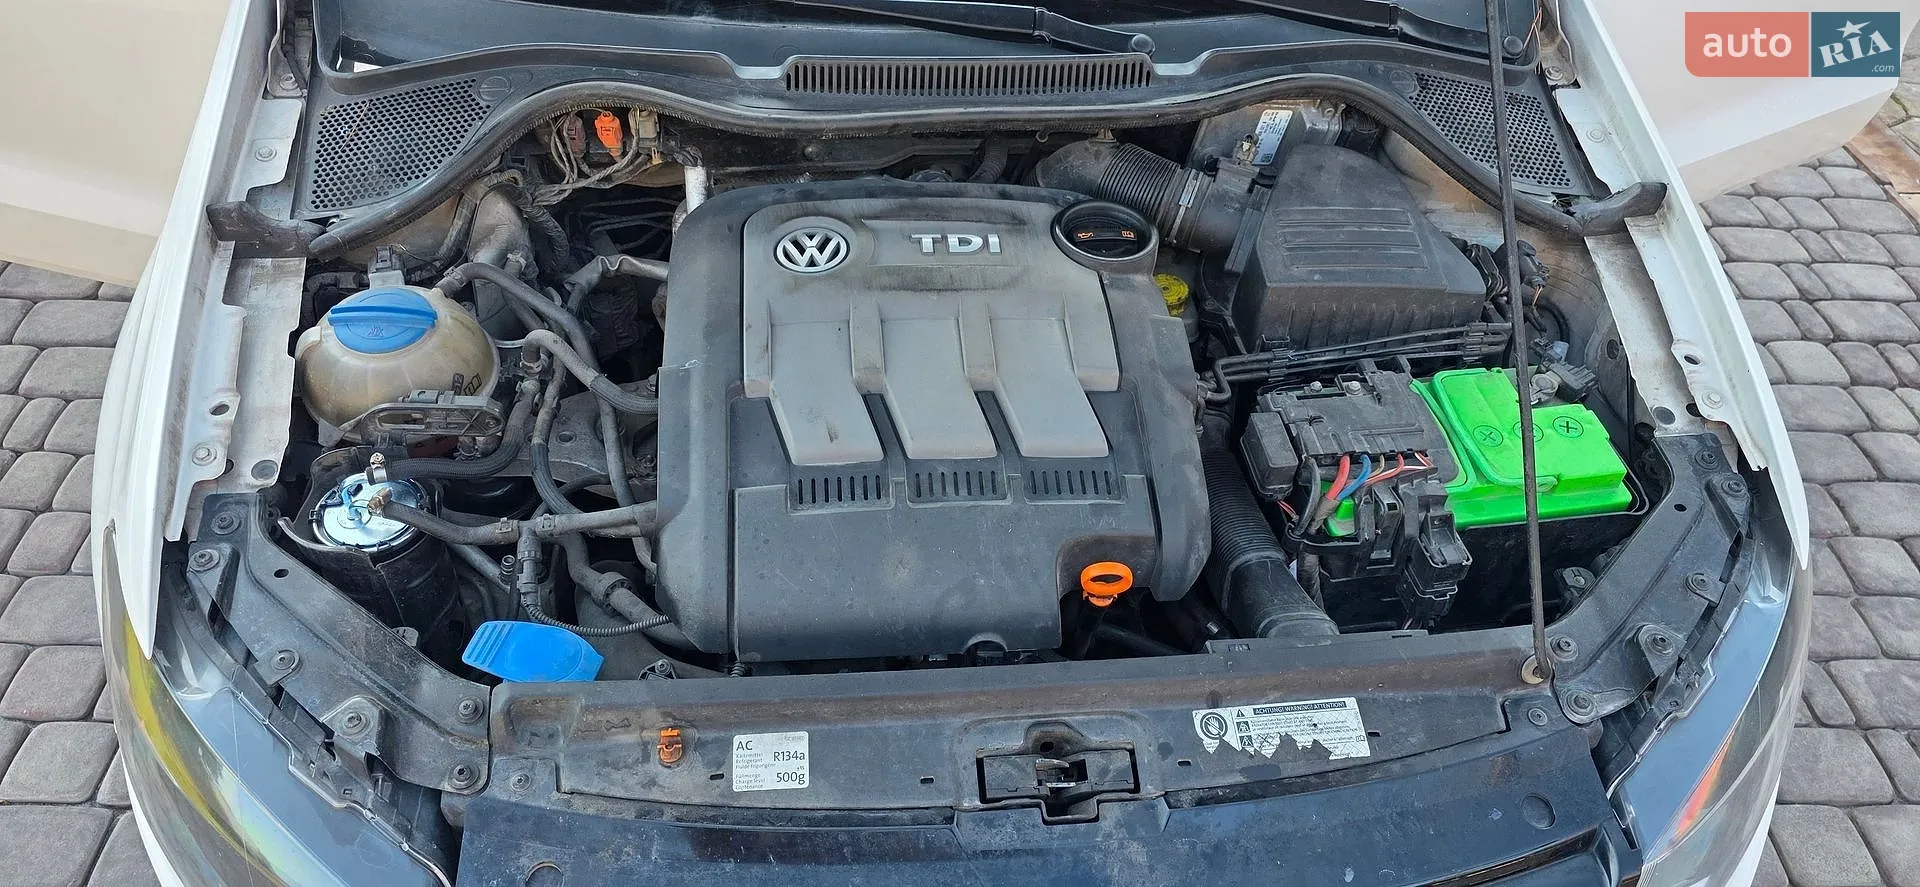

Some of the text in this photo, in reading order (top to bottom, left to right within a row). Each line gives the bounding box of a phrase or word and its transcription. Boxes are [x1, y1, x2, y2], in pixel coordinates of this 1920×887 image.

[911, 233, 1001, 254] TDI
[1285, 704, 1312, 712] WARNING!
[1314, 701, 1346, 710] ATTENTION!
[736, 740, 753, 751] AC
[773, 750, 805, 761] R134a
[776, 771, 805, 785] 500g
